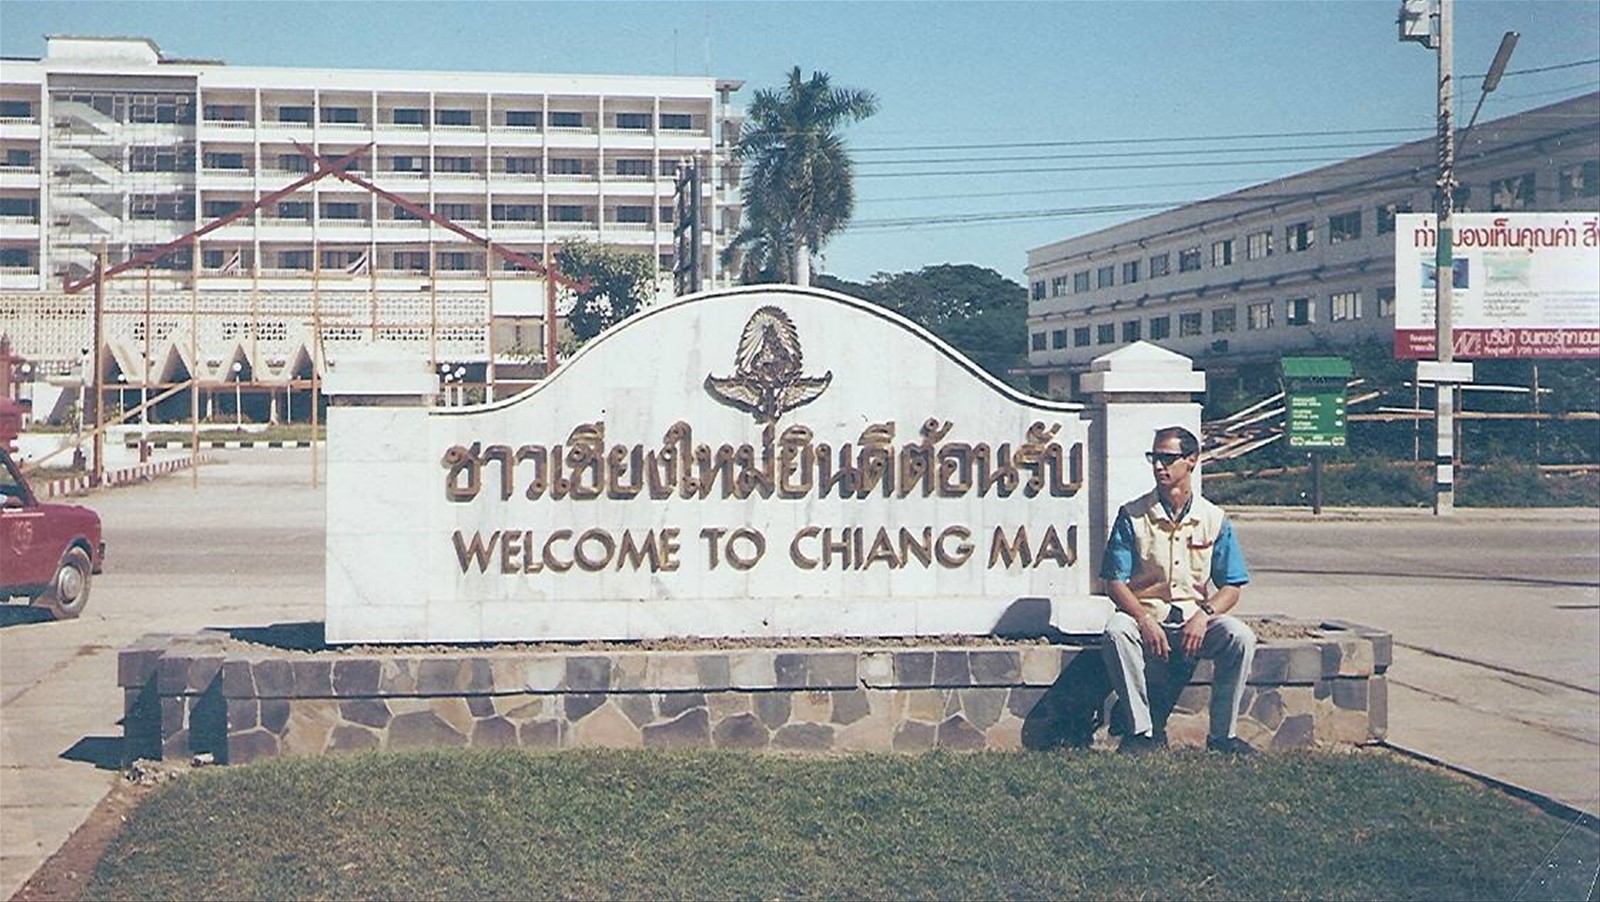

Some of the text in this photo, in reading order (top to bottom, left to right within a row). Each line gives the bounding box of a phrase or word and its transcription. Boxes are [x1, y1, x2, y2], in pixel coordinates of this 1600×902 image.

[1414, 218, 1577, 253] ท่ามองเห็นคุณค่า
[444, 417, 1084, 501] ชาวเชียงใหม่ยินดีต้อนรับ
[452, 525, 1078, 574] WELCOME TO CHIANG MAI
